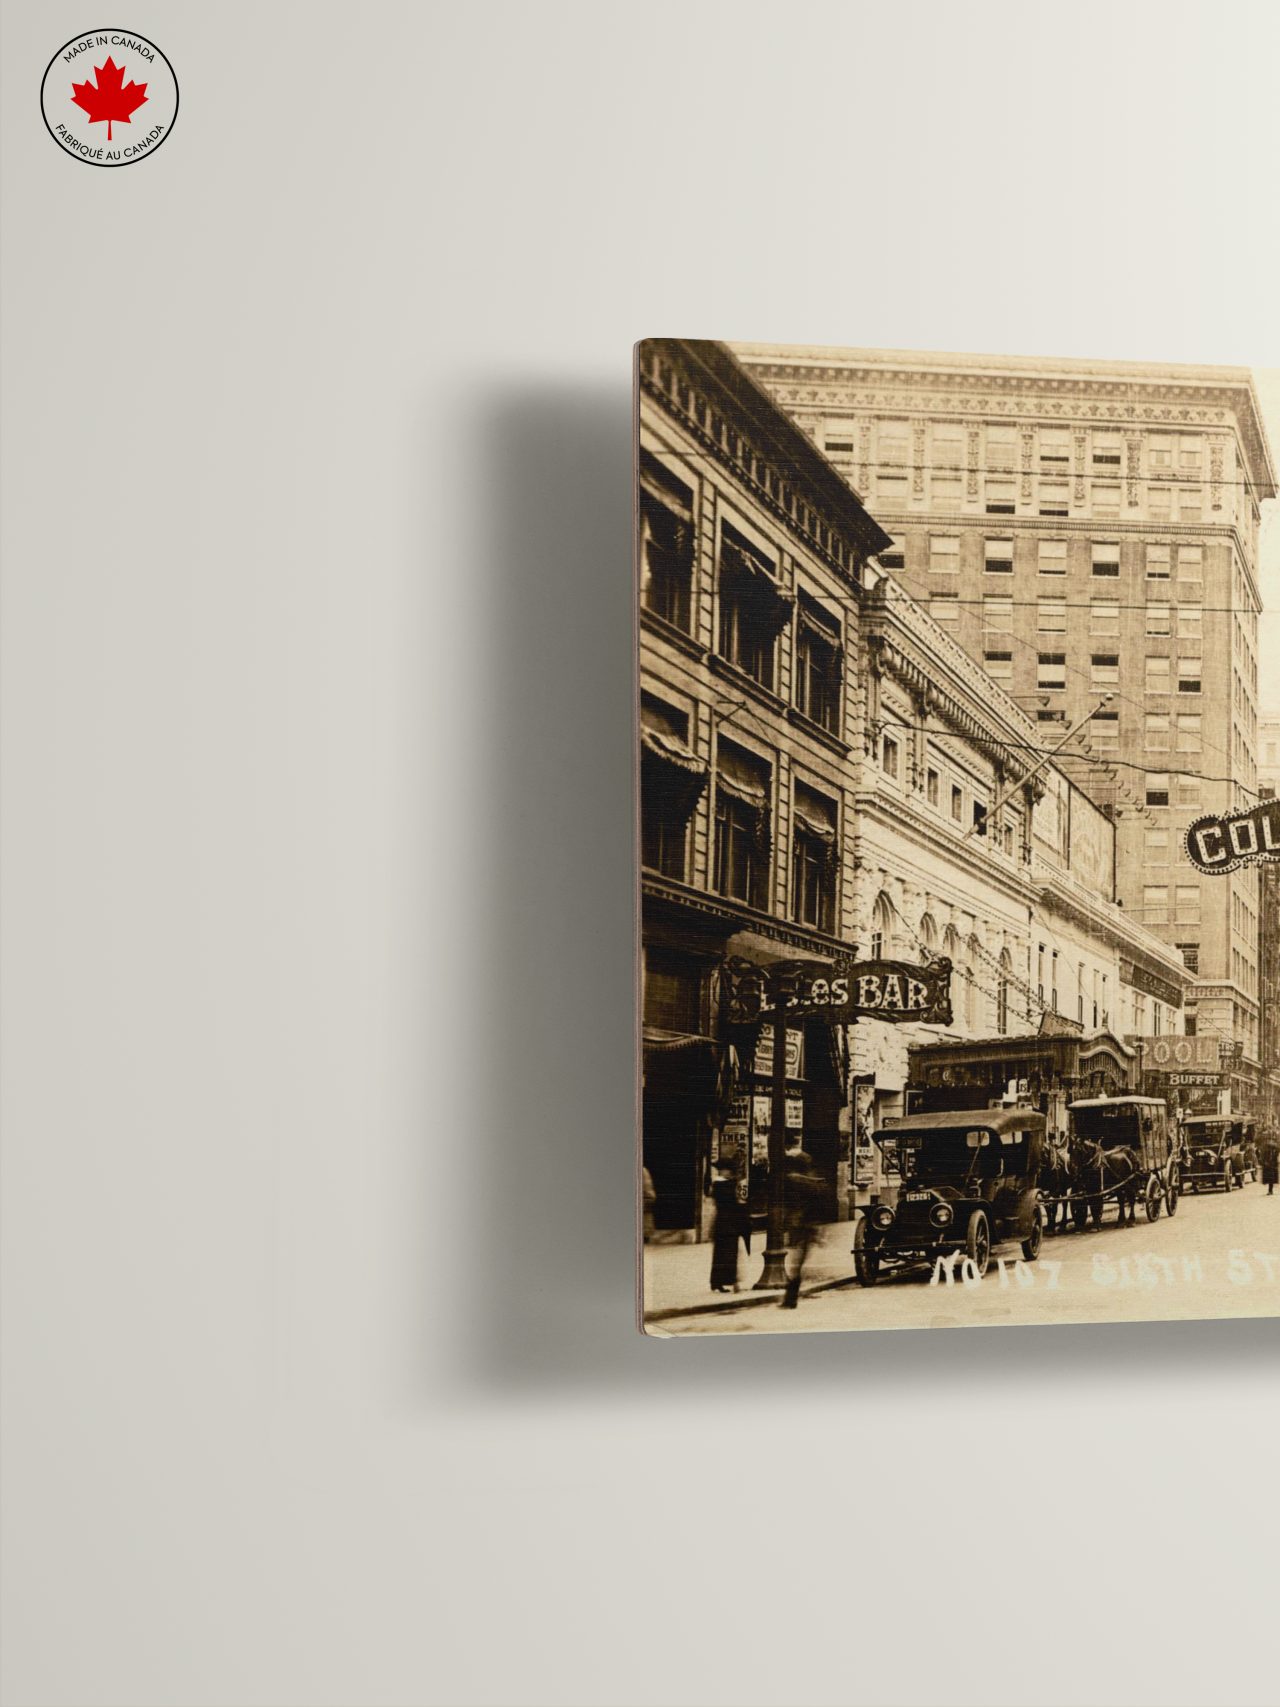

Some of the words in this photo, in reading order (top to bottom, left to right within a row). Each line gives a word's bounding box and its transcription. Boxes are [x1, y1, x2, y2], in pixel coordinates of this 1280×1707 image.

[854, 973, 932, 1010] BAR
[1133, 1041, 1213, 1063] POOL
[1169, 1073, 1220, 1085] BUFFET
